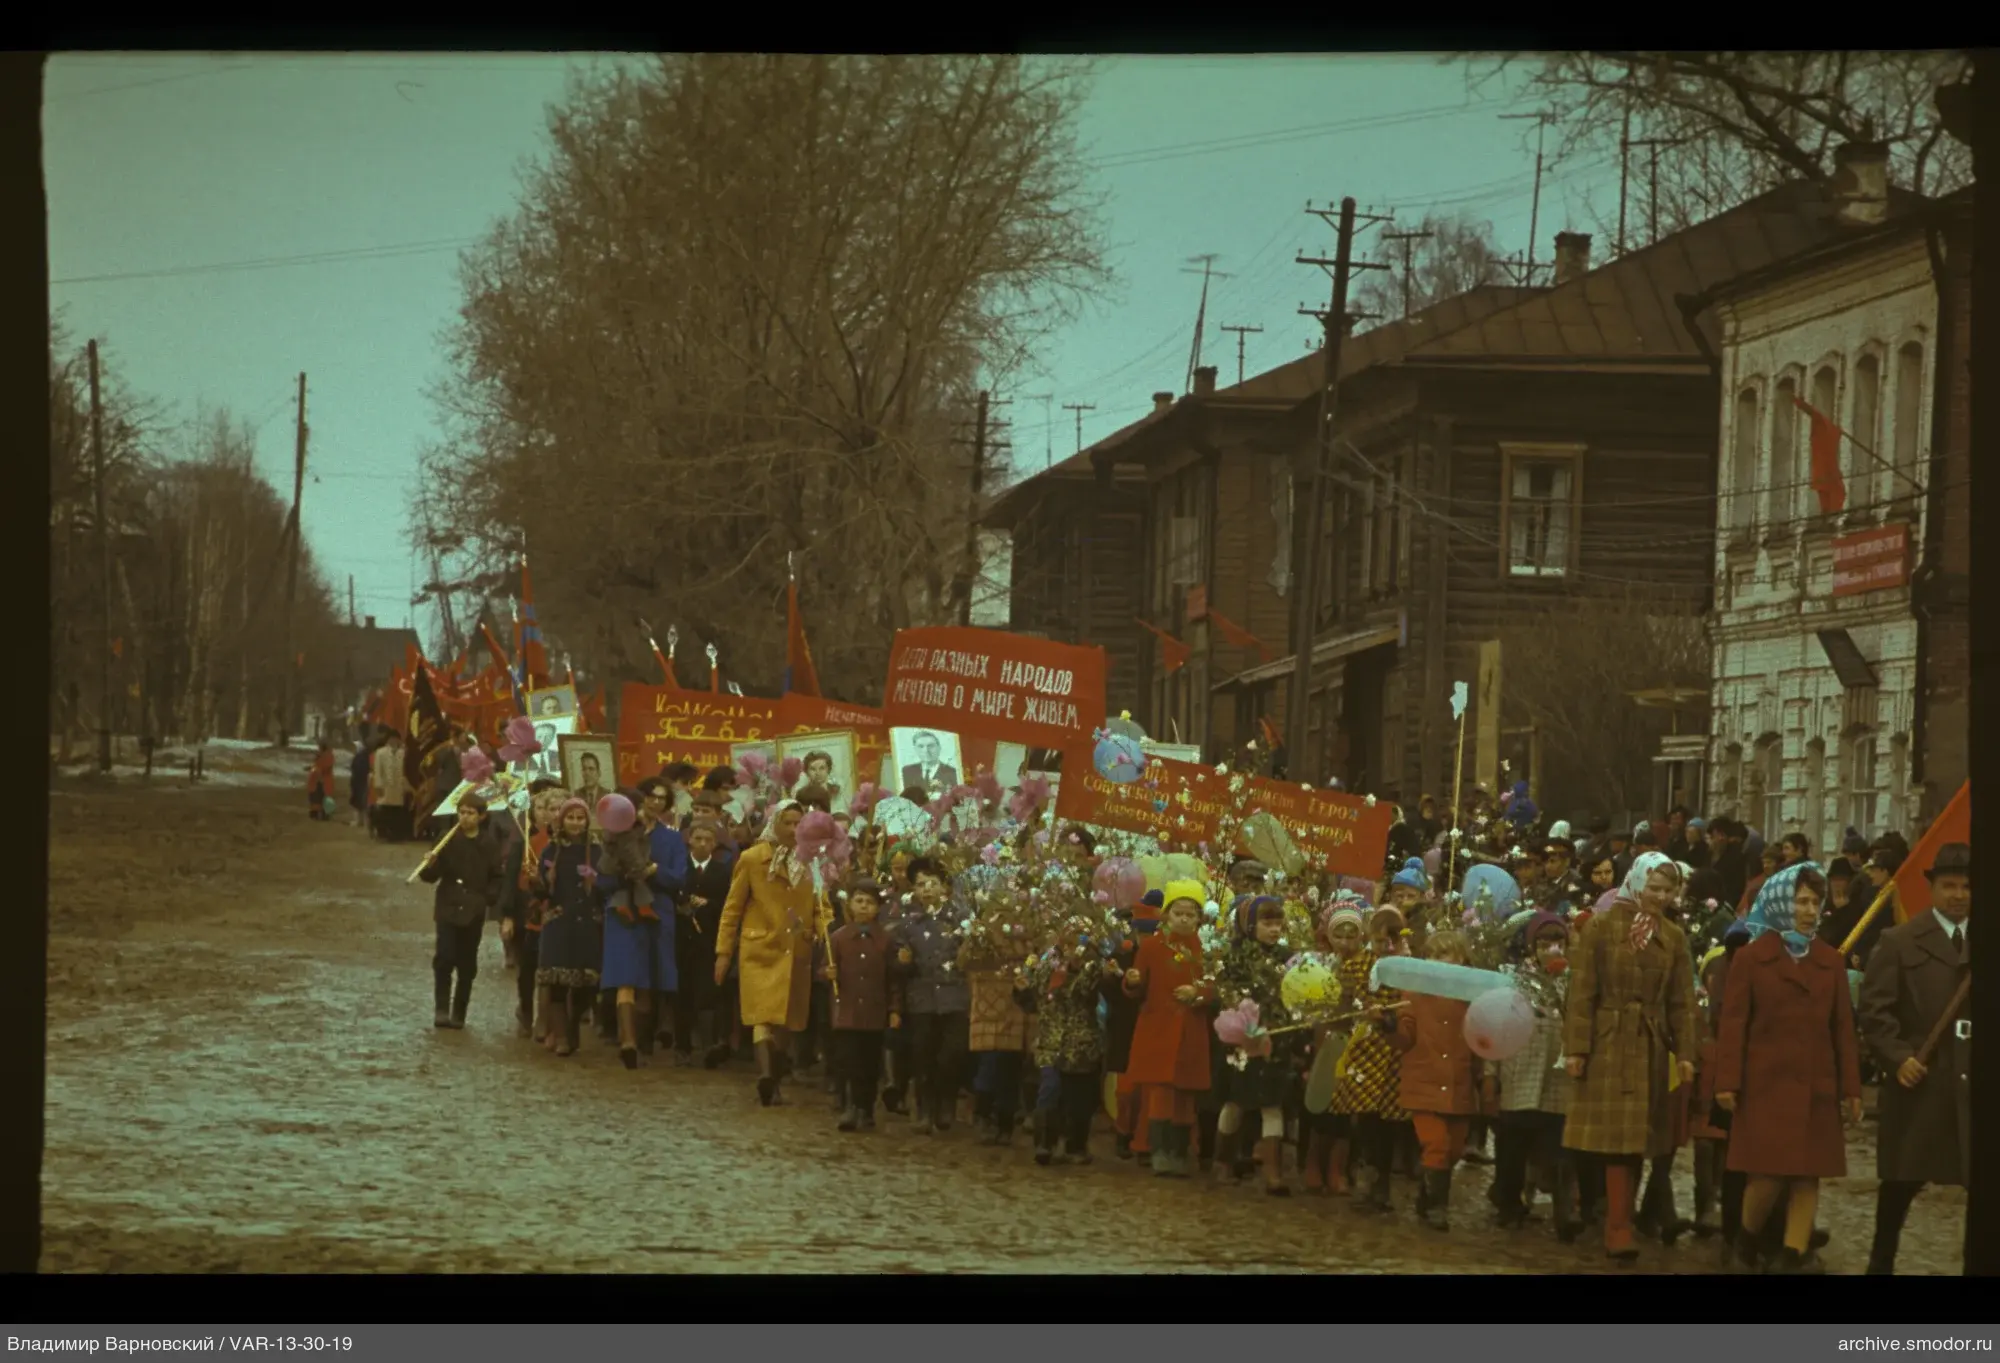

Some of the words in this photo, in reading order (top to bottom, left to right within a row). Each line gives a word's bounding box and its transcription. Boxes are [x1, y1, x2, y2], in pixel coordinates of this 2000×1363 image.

[897, 647, 927, 671] ДЕТИ
[929, 649, 990, 678] РАЗНЫХ
[1000, 660, 1074, 695] НАРОДОВ
[893, 678, 948, 707] МЕЧТОЮ
[952, 684, 964, 709] О
[970, 688, 1016, 719] МИРЕ
